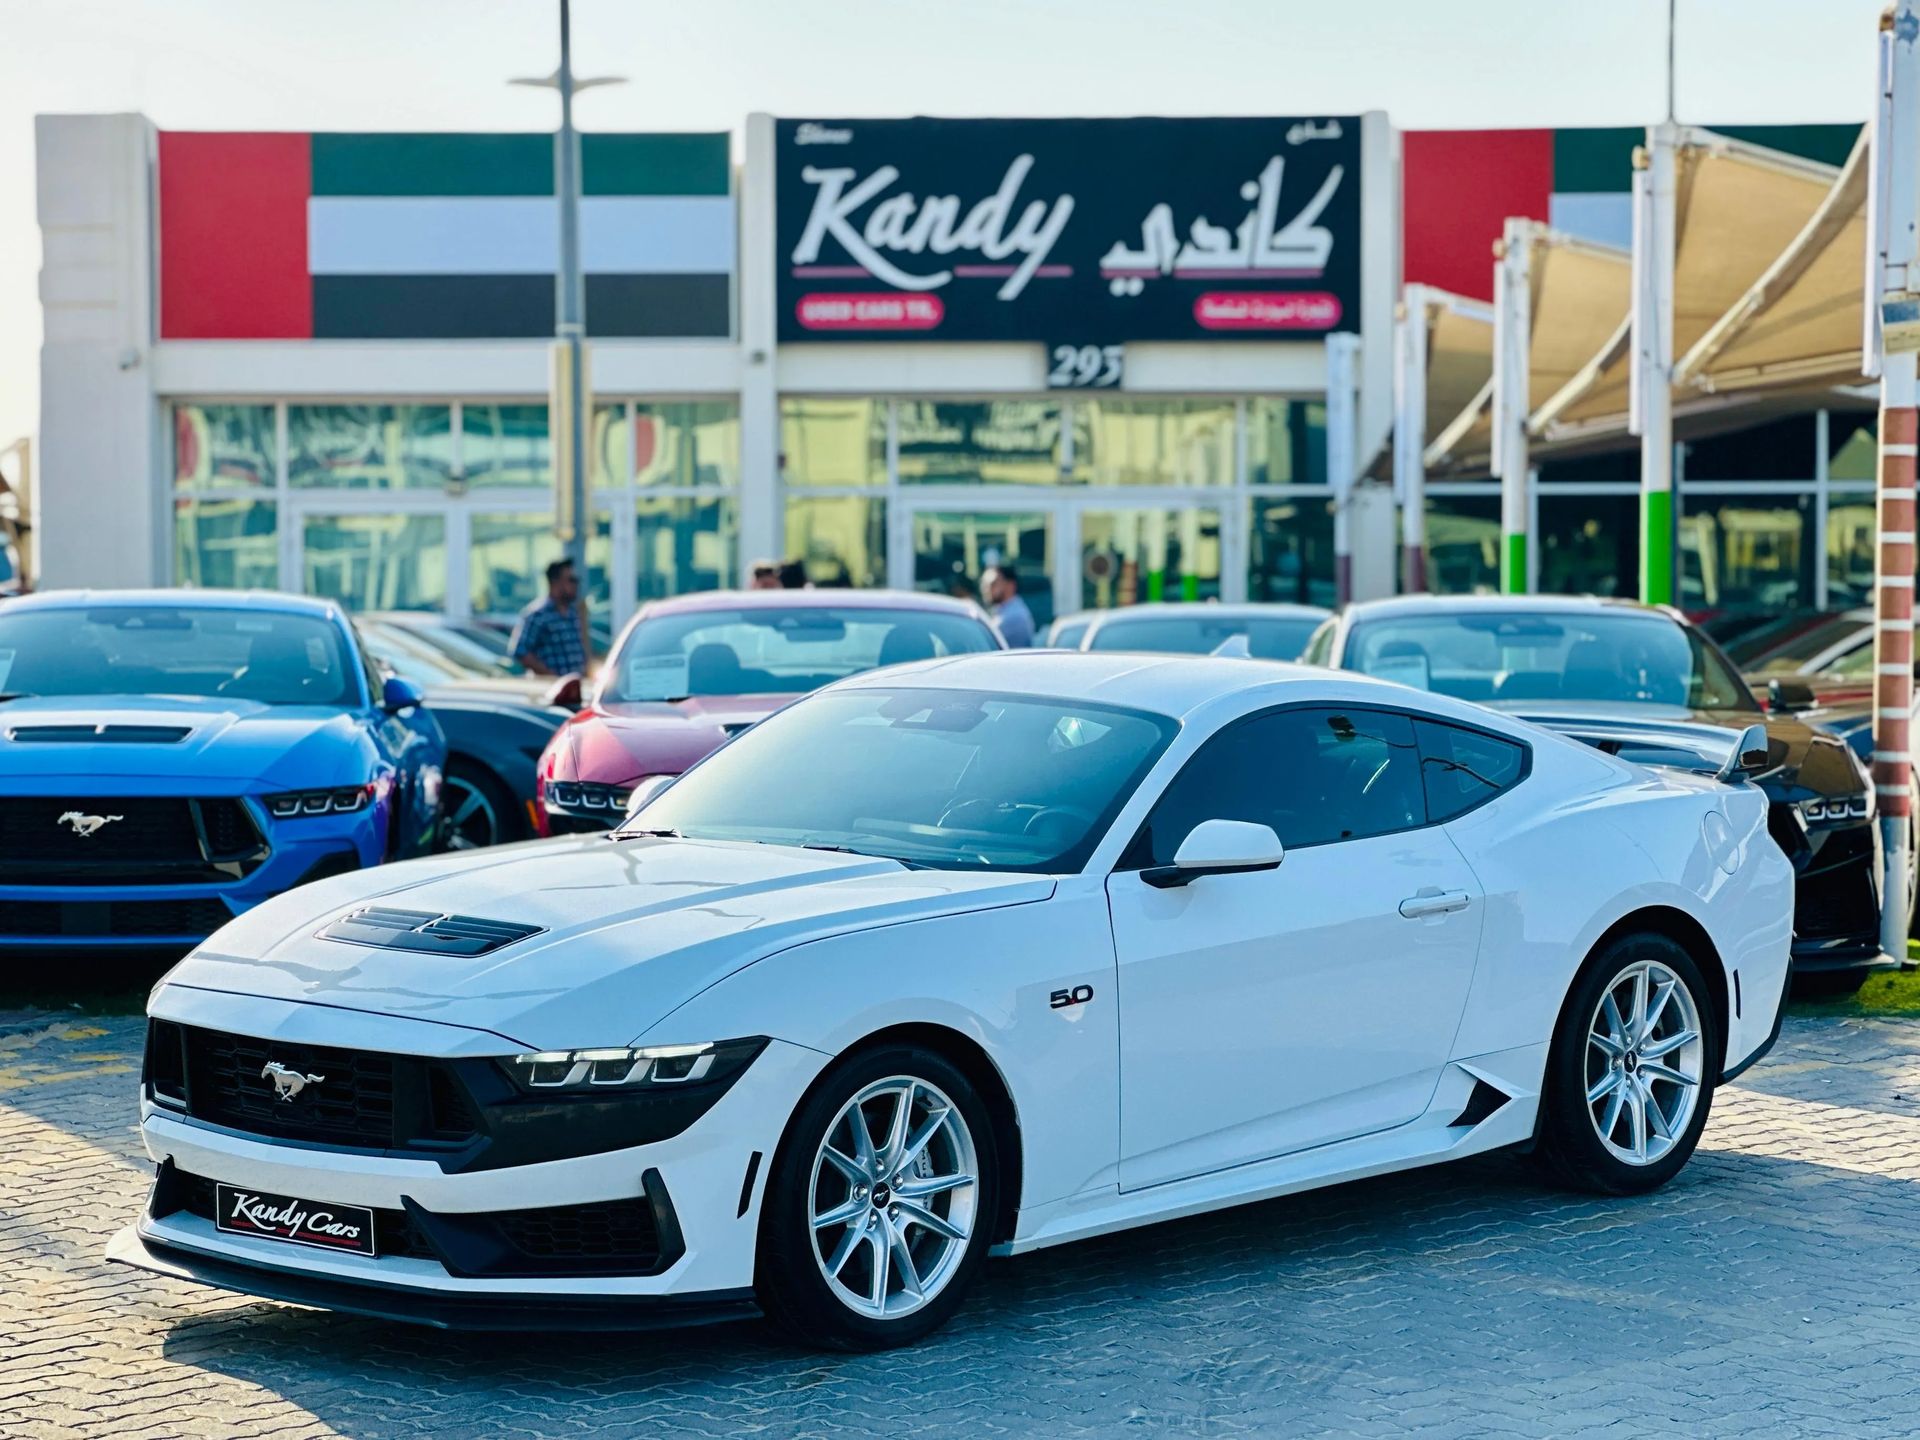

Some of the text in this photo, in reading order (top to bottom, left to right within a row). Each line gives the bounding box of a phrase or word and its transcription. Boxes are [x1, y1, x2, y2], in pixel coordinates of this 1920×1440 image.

[791, 153, 1075, 300] Kandy
[1099, 154, 1344, 297] كاندي
[1050, 984, 1093, 1009] 5.0
[231, 1192, 361, 1239] Kandy Cars
